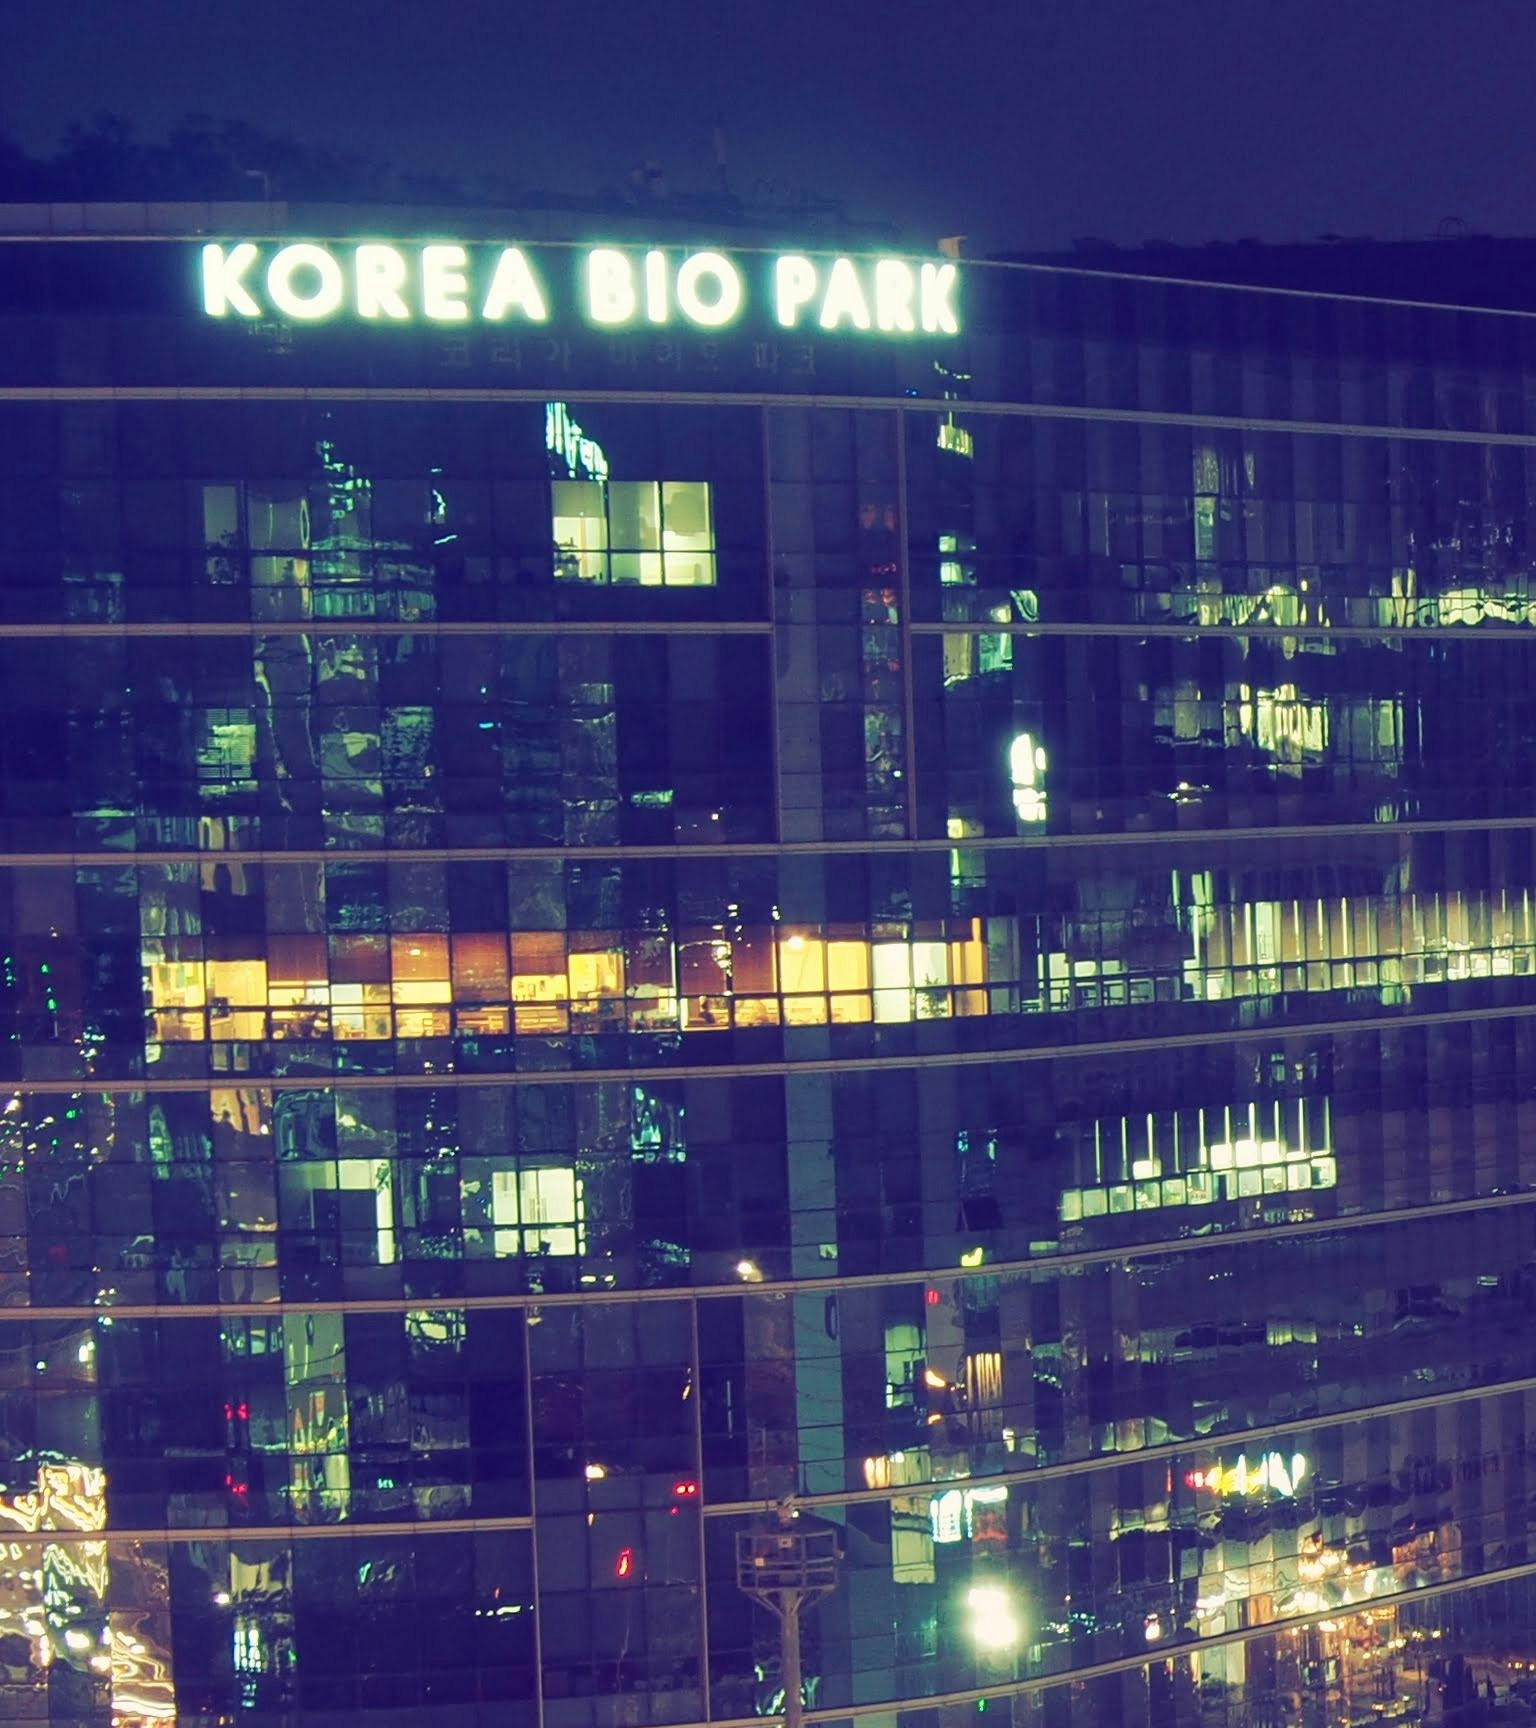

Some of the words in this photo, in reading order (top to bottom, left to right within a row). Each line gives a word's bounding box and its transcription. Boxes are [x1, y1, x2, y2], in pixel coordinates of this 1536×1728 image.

[201, 242, 548, 321] KOREA
[587, 248, 742, 326] BIO
[775, 255, 960, 335] PARK
